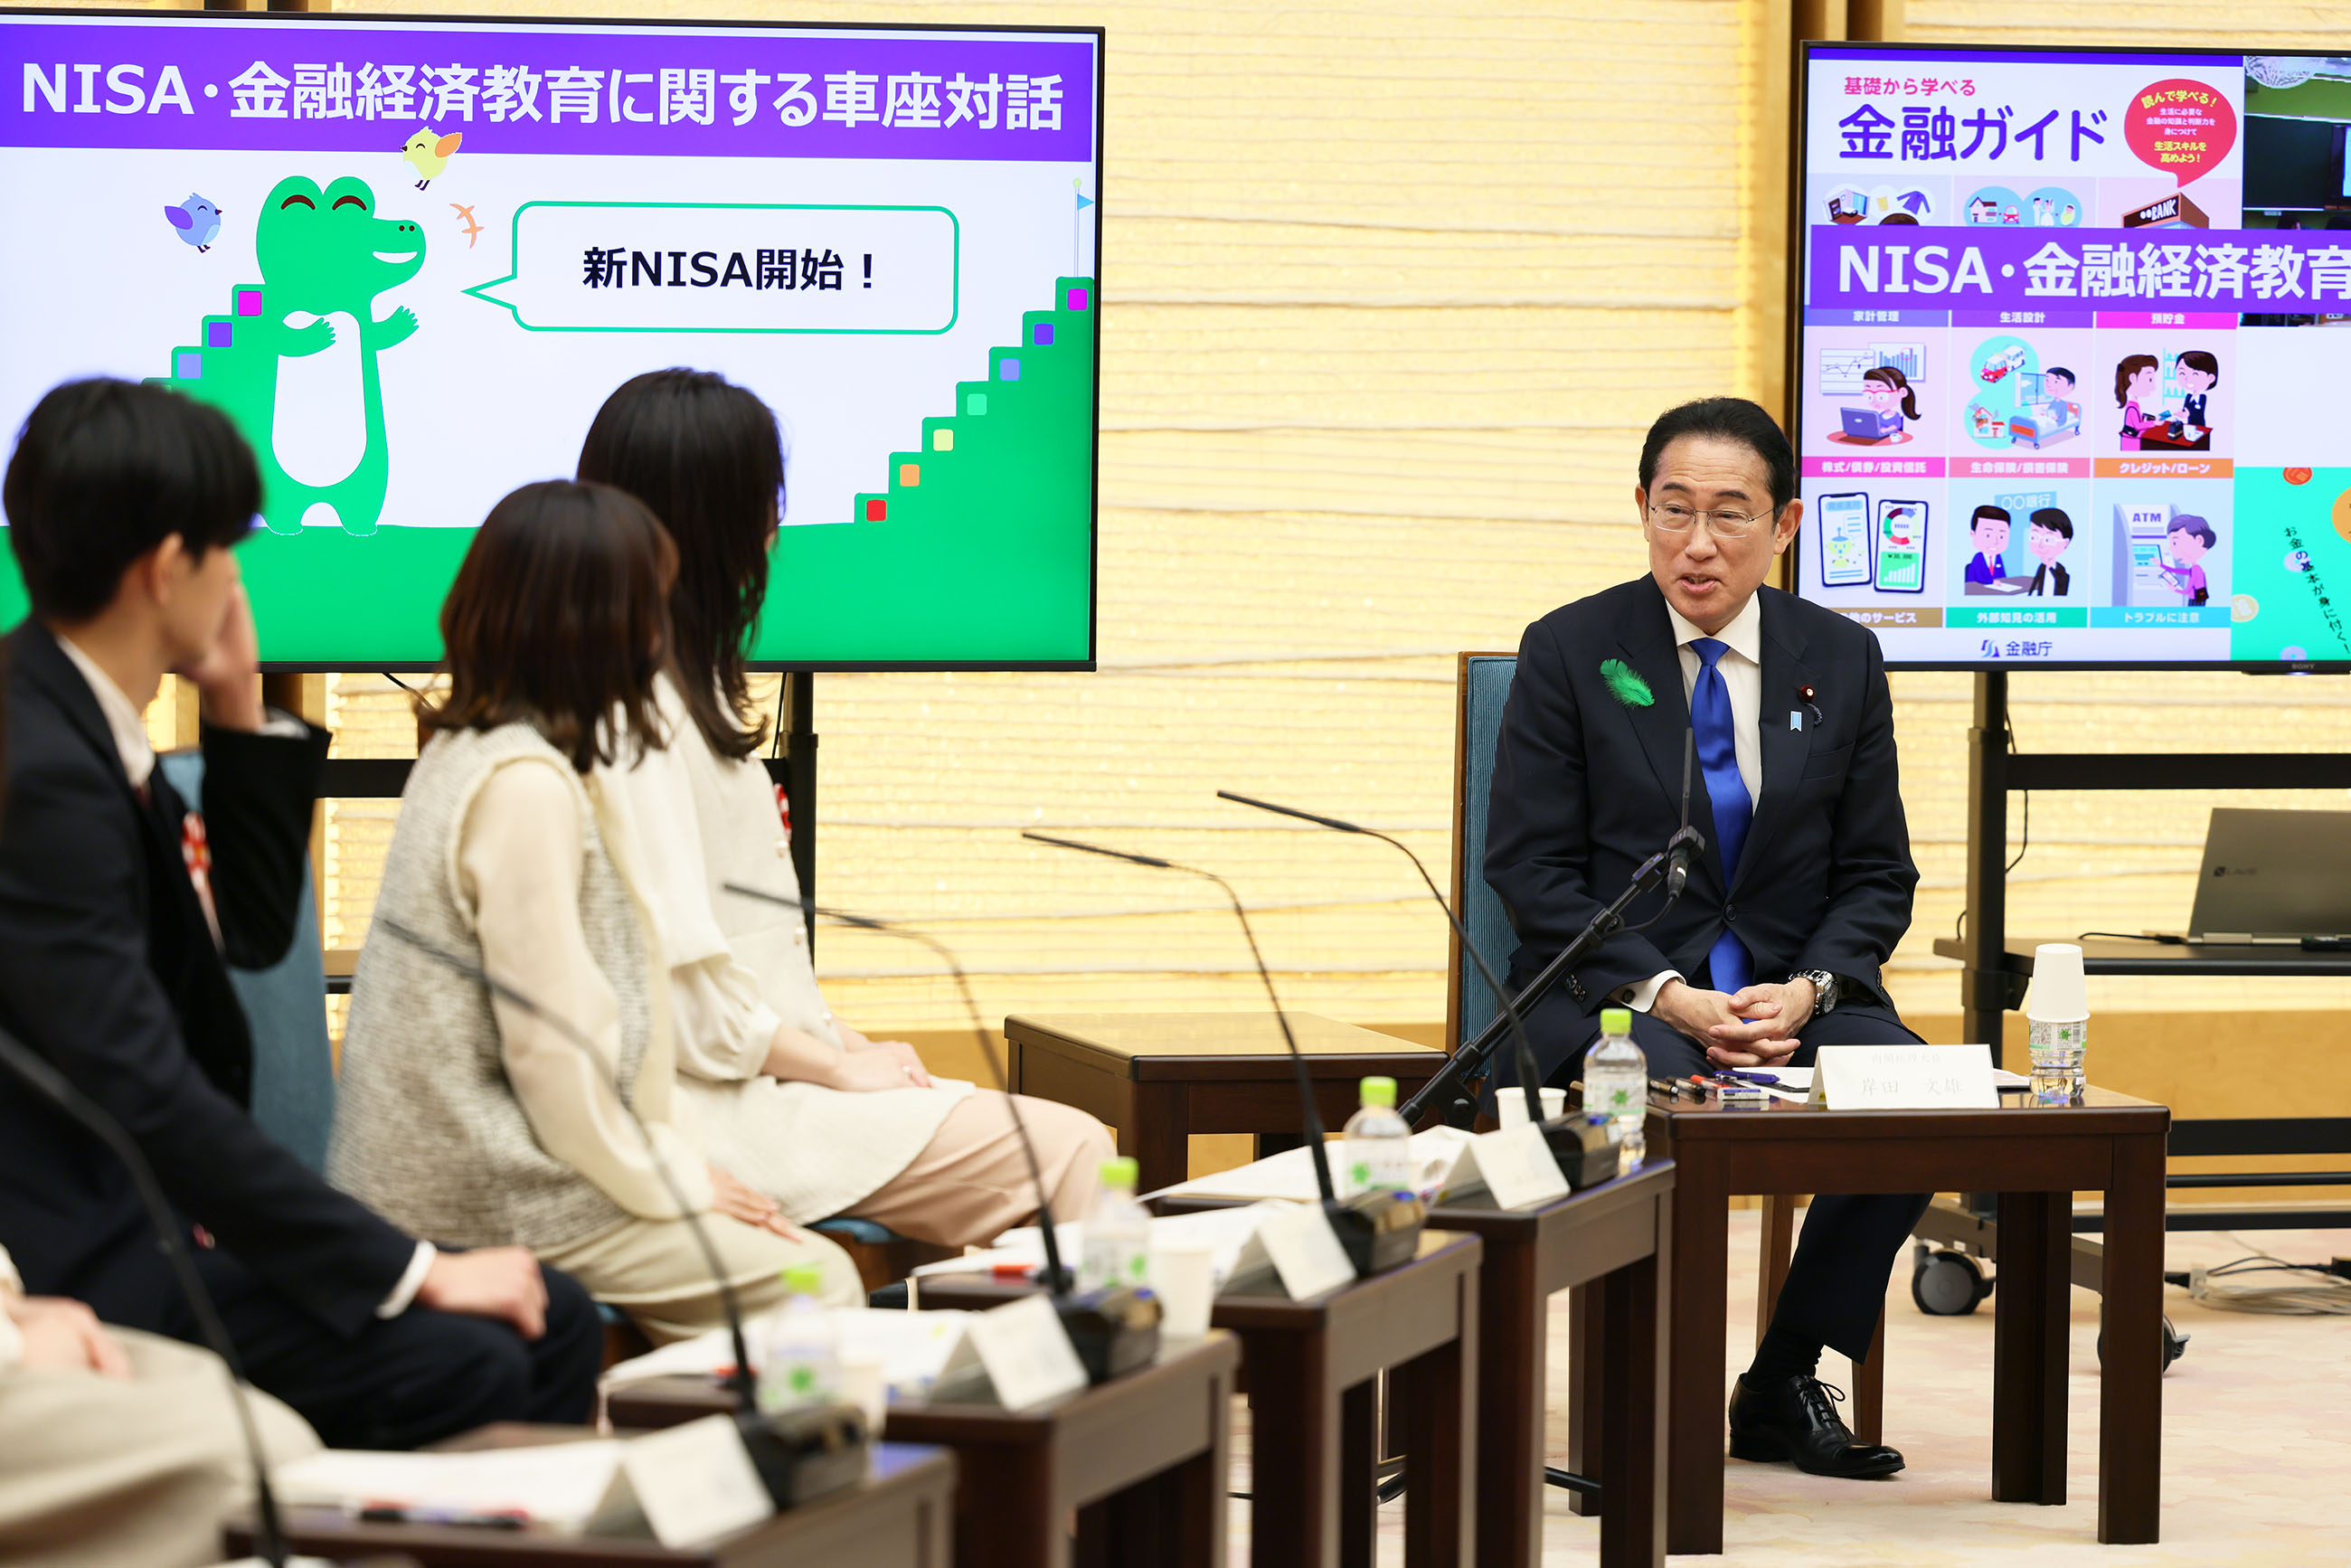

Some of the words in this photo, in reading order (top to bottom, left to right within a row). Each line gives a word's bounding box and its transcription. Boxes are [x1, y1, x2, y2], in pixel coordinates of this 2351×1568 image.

[1845, 77, 1976, 96] 基礎から学べる
[23, 61, 1063, 130] NISA・金融経済教育に関する車座対話
[1838, 104, 2108, 162] 金融ガイド
[2154, 141, 2206, 151] 生活スキルを
[582, 247, 873, 291] 新NISA開始！
[1838, 241, 2351, 300] NISA・金融経済教育
[1853, 310, 1899, 322] 家計管理
[1999, 312, 2045, 324] 生活設計
[2151, 313, 2185, 325] 預貯金
[2132, 513, 2161, 523] ATM
[1977, 612, 2057, 624] 外部知見の活用
[2125, 611, 2200, 623] トラブルに注意
[2006, 640, 2053, 657] 金融庁
